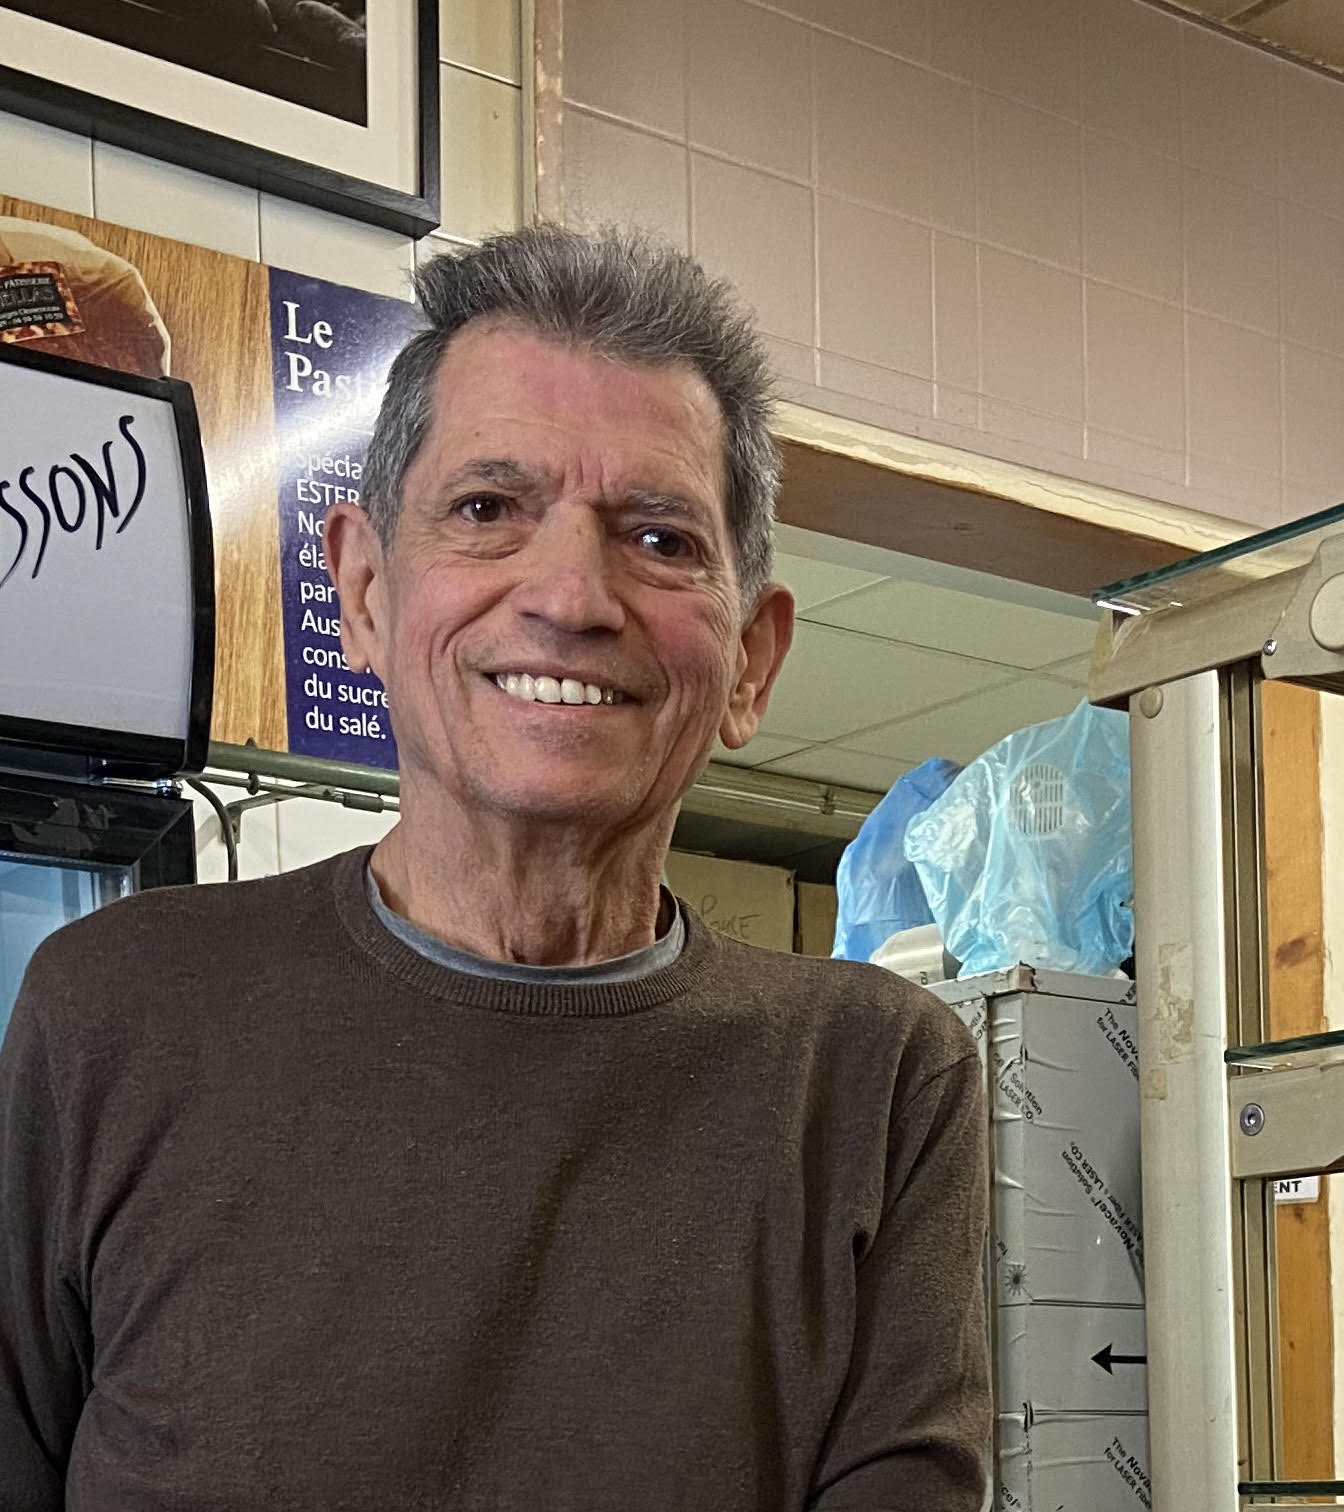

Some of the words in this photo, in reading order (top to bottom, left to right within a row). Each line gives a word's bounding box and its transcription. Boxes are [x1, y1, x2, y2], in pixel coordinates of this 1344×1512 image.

[282, 301, 334, 348] Le
[300, 580, 335, 609] par
[301, 608, 341, 639] Aus
[304, 674, 332, 700] du
[305, 707, 334, 733] du
[339, 715, 387, 740] salé.
[1061, 1150, 1094, 1195] Solution
